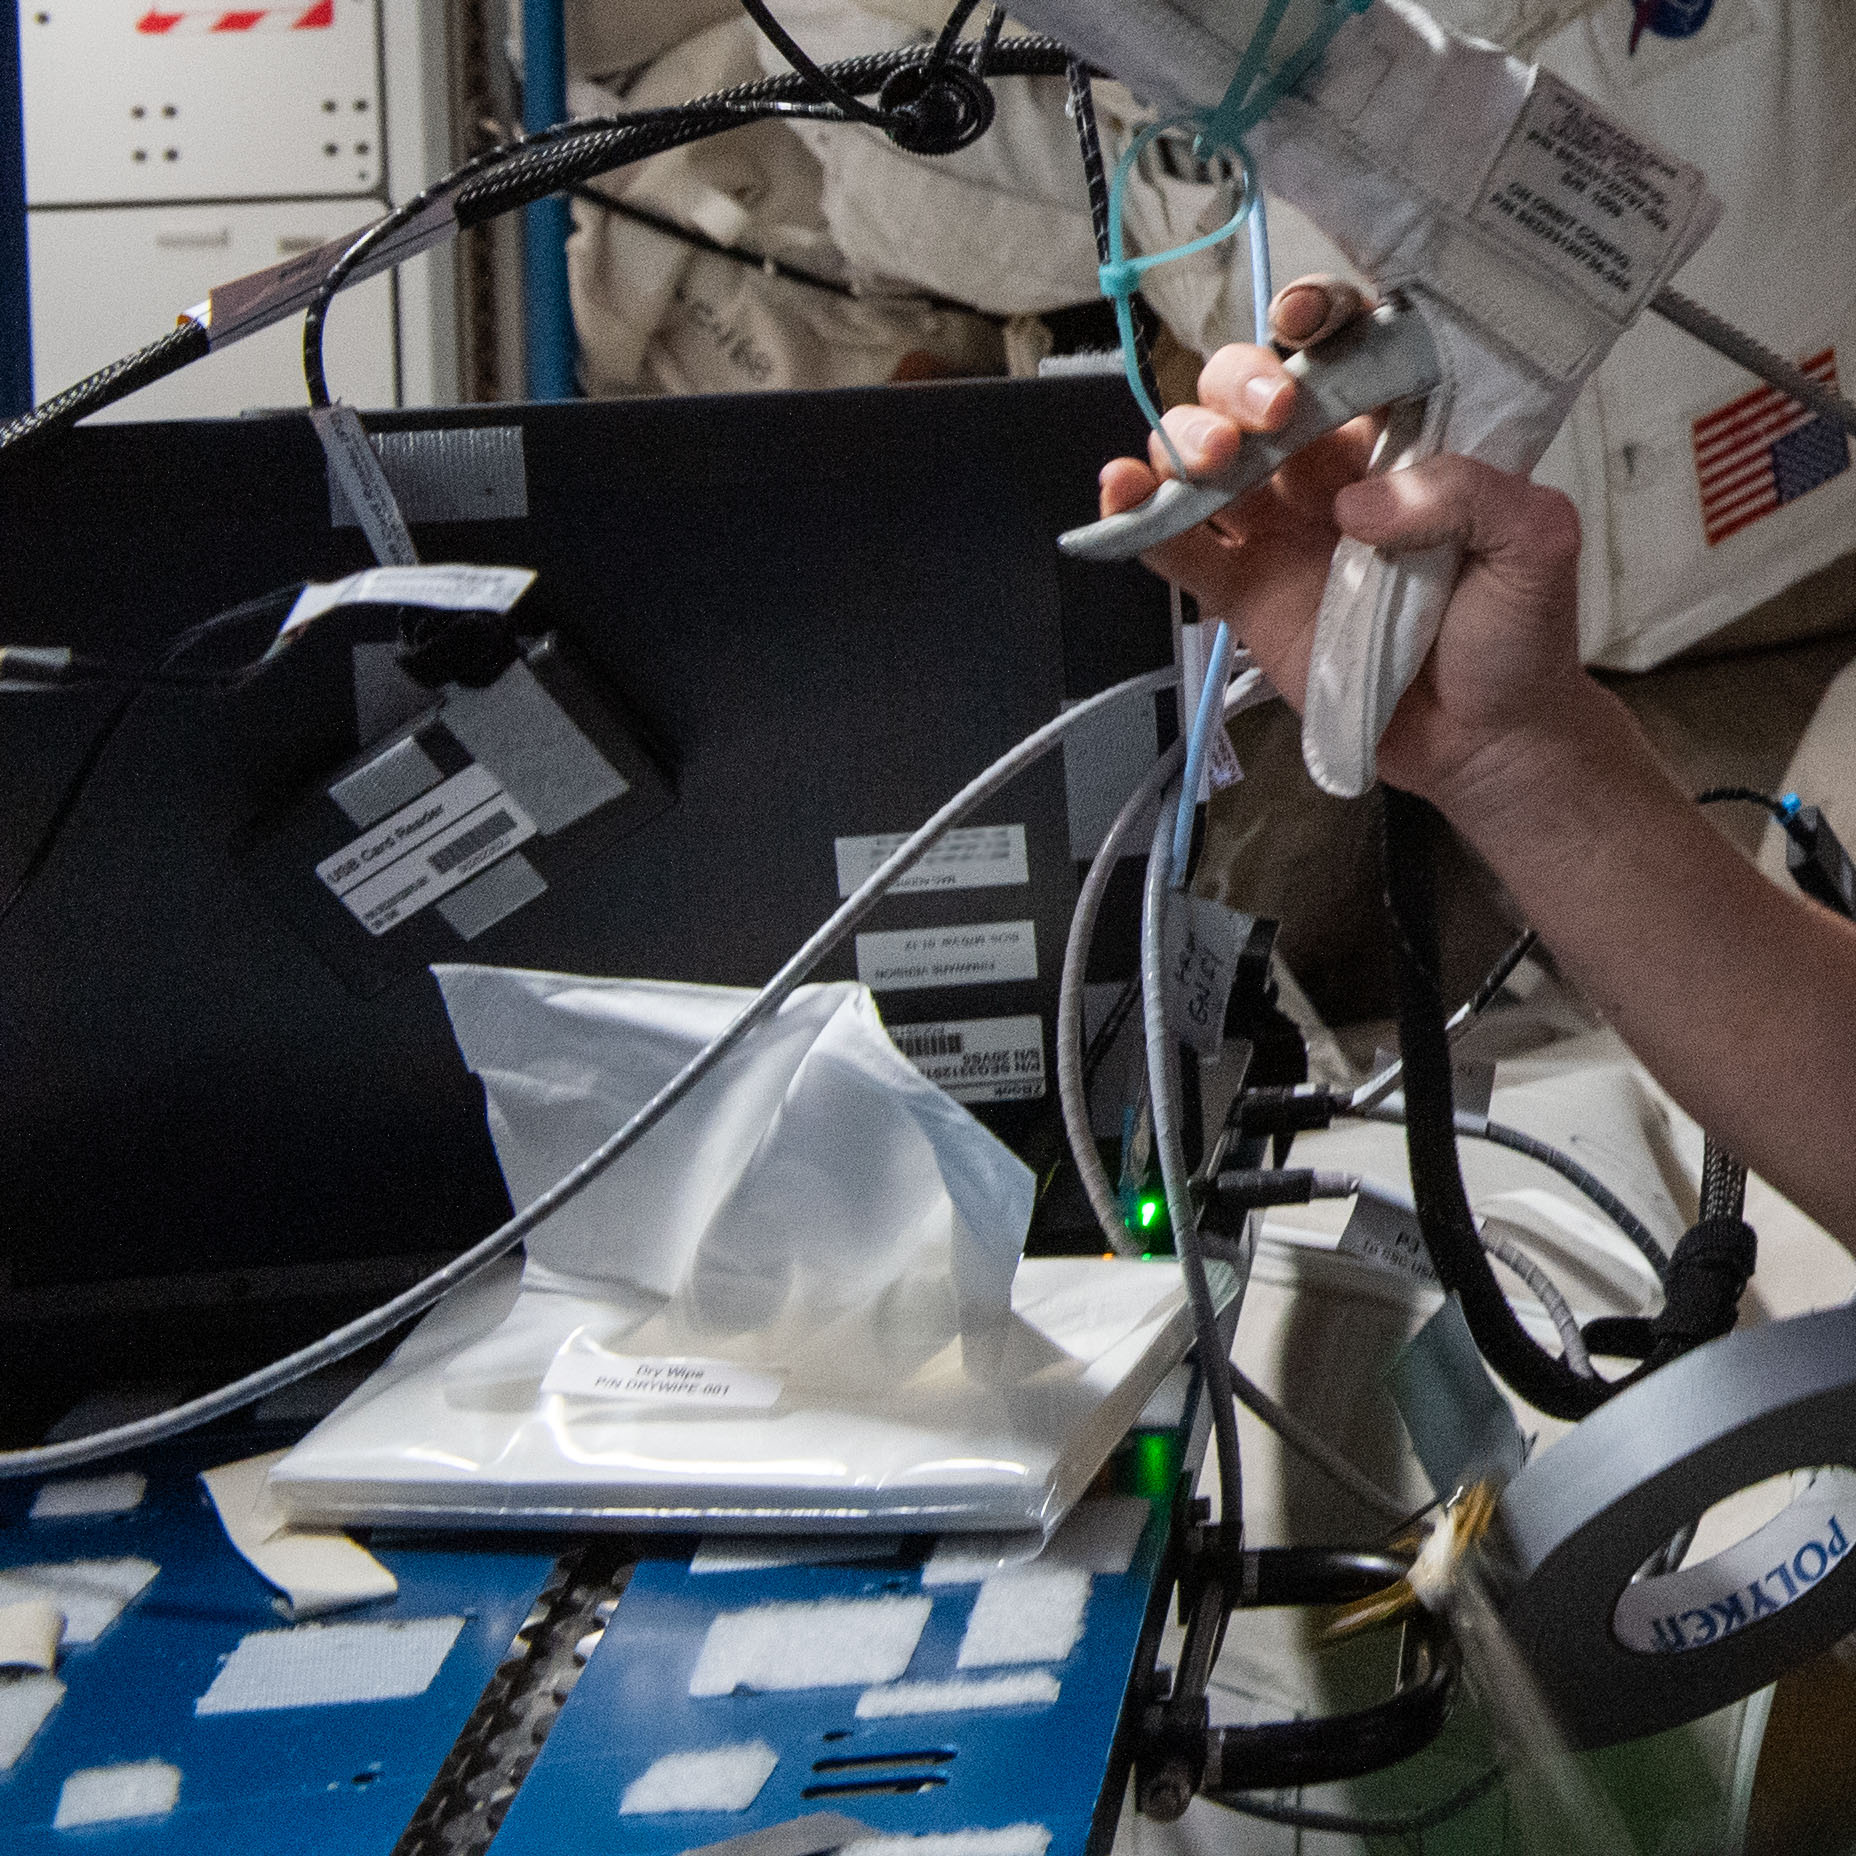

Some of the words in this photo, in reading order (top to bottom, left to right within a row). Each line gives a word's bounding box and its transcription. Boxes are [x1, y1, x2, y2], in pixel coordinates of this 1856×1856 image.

[360, 833, 397, 863] Card
[394, 803, 446, 841] Reader
[873, 964, 928, 979] VERSION
[932, 960, 995, 974] FIRMWARE
[636, 1363, 663, 1379] Dry
[667, 1365, 705, 1380] Wipe
